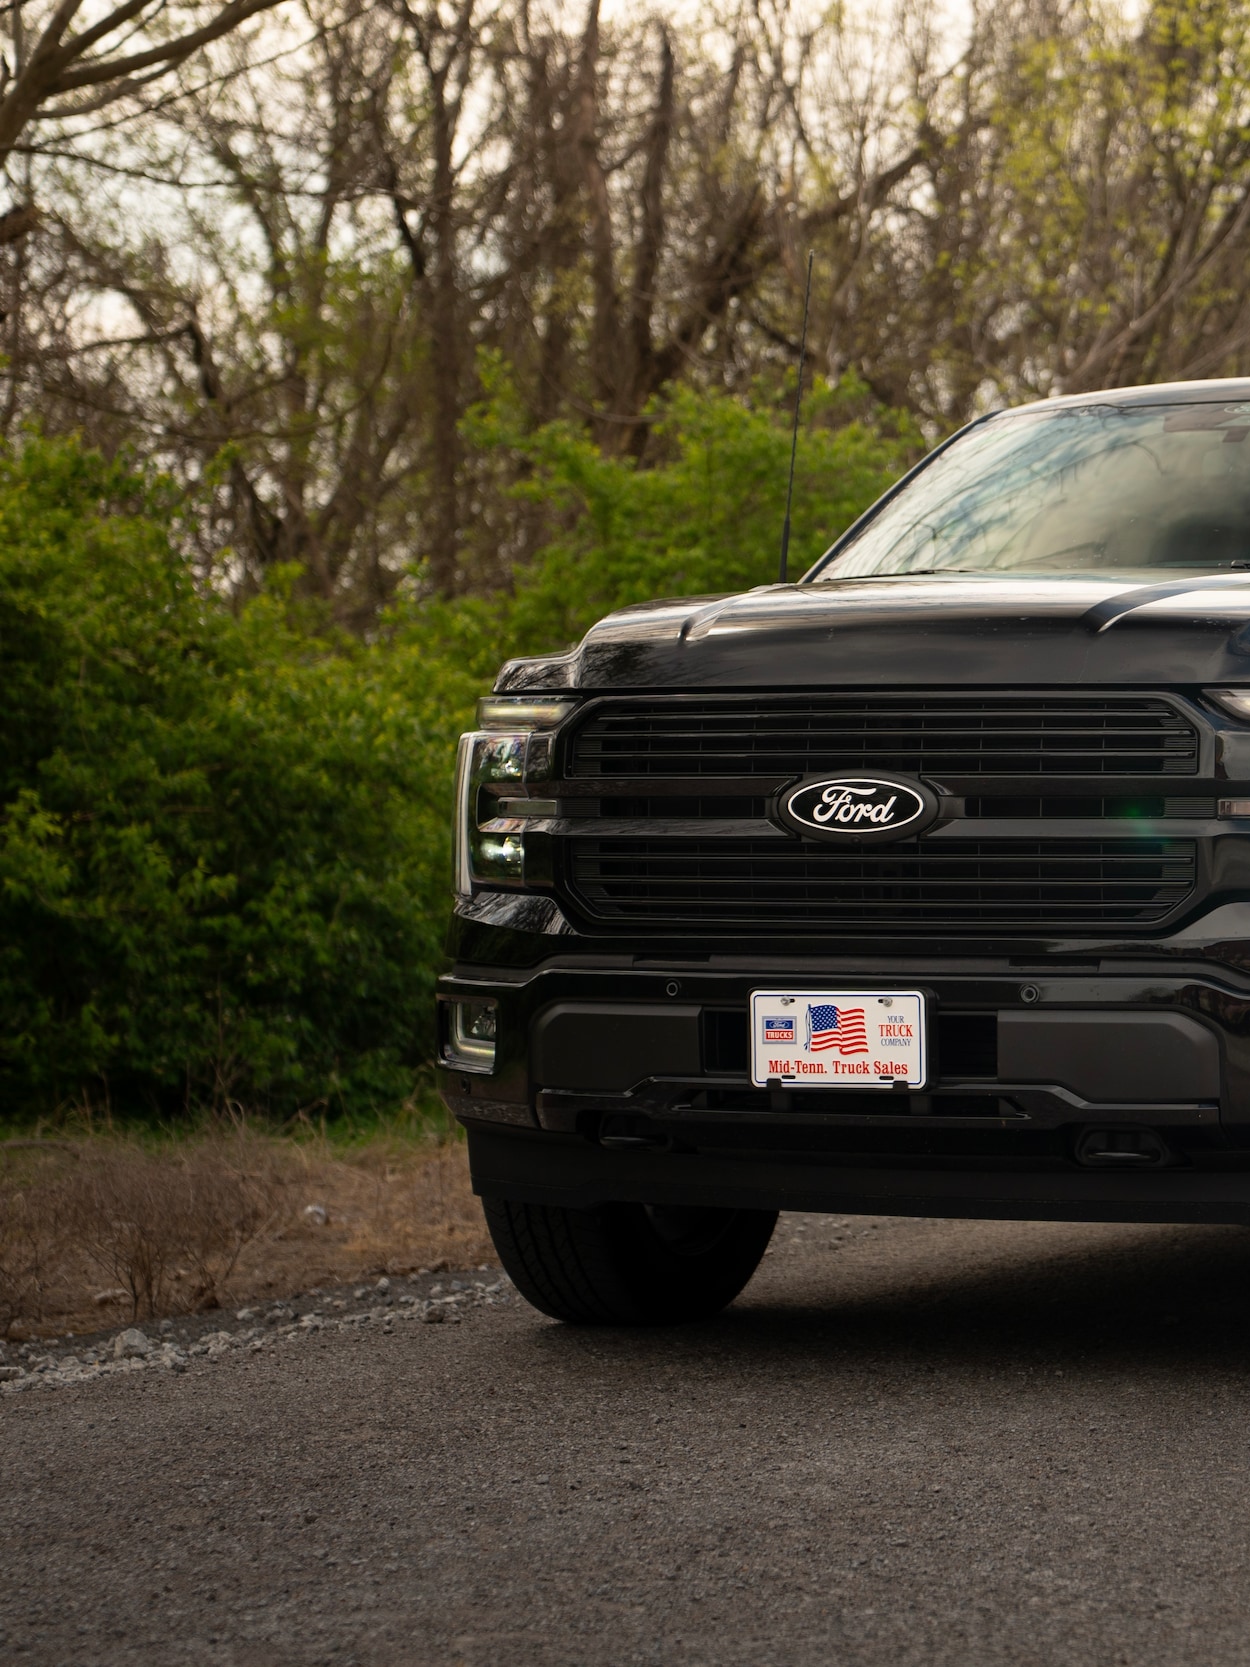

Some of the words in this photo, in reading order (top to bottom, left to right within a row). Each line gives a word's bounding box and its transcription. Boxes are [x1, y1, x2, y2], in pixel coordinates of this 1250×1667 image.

[813, 786, 897, 823] Ford
[887, 1015, 905, 1024] YOUR
[766, 1031, 793, 1039] TRUCKS
[878, 1024, 913, 1037] TRUCK
[880, 1038, 912, 1047] COMPANY
[768, 1060, 828, 1074] Mid-Tenn.
[832, 1060, 870, 1074] Truck
[873, 1060, 908, 1075] Sales
